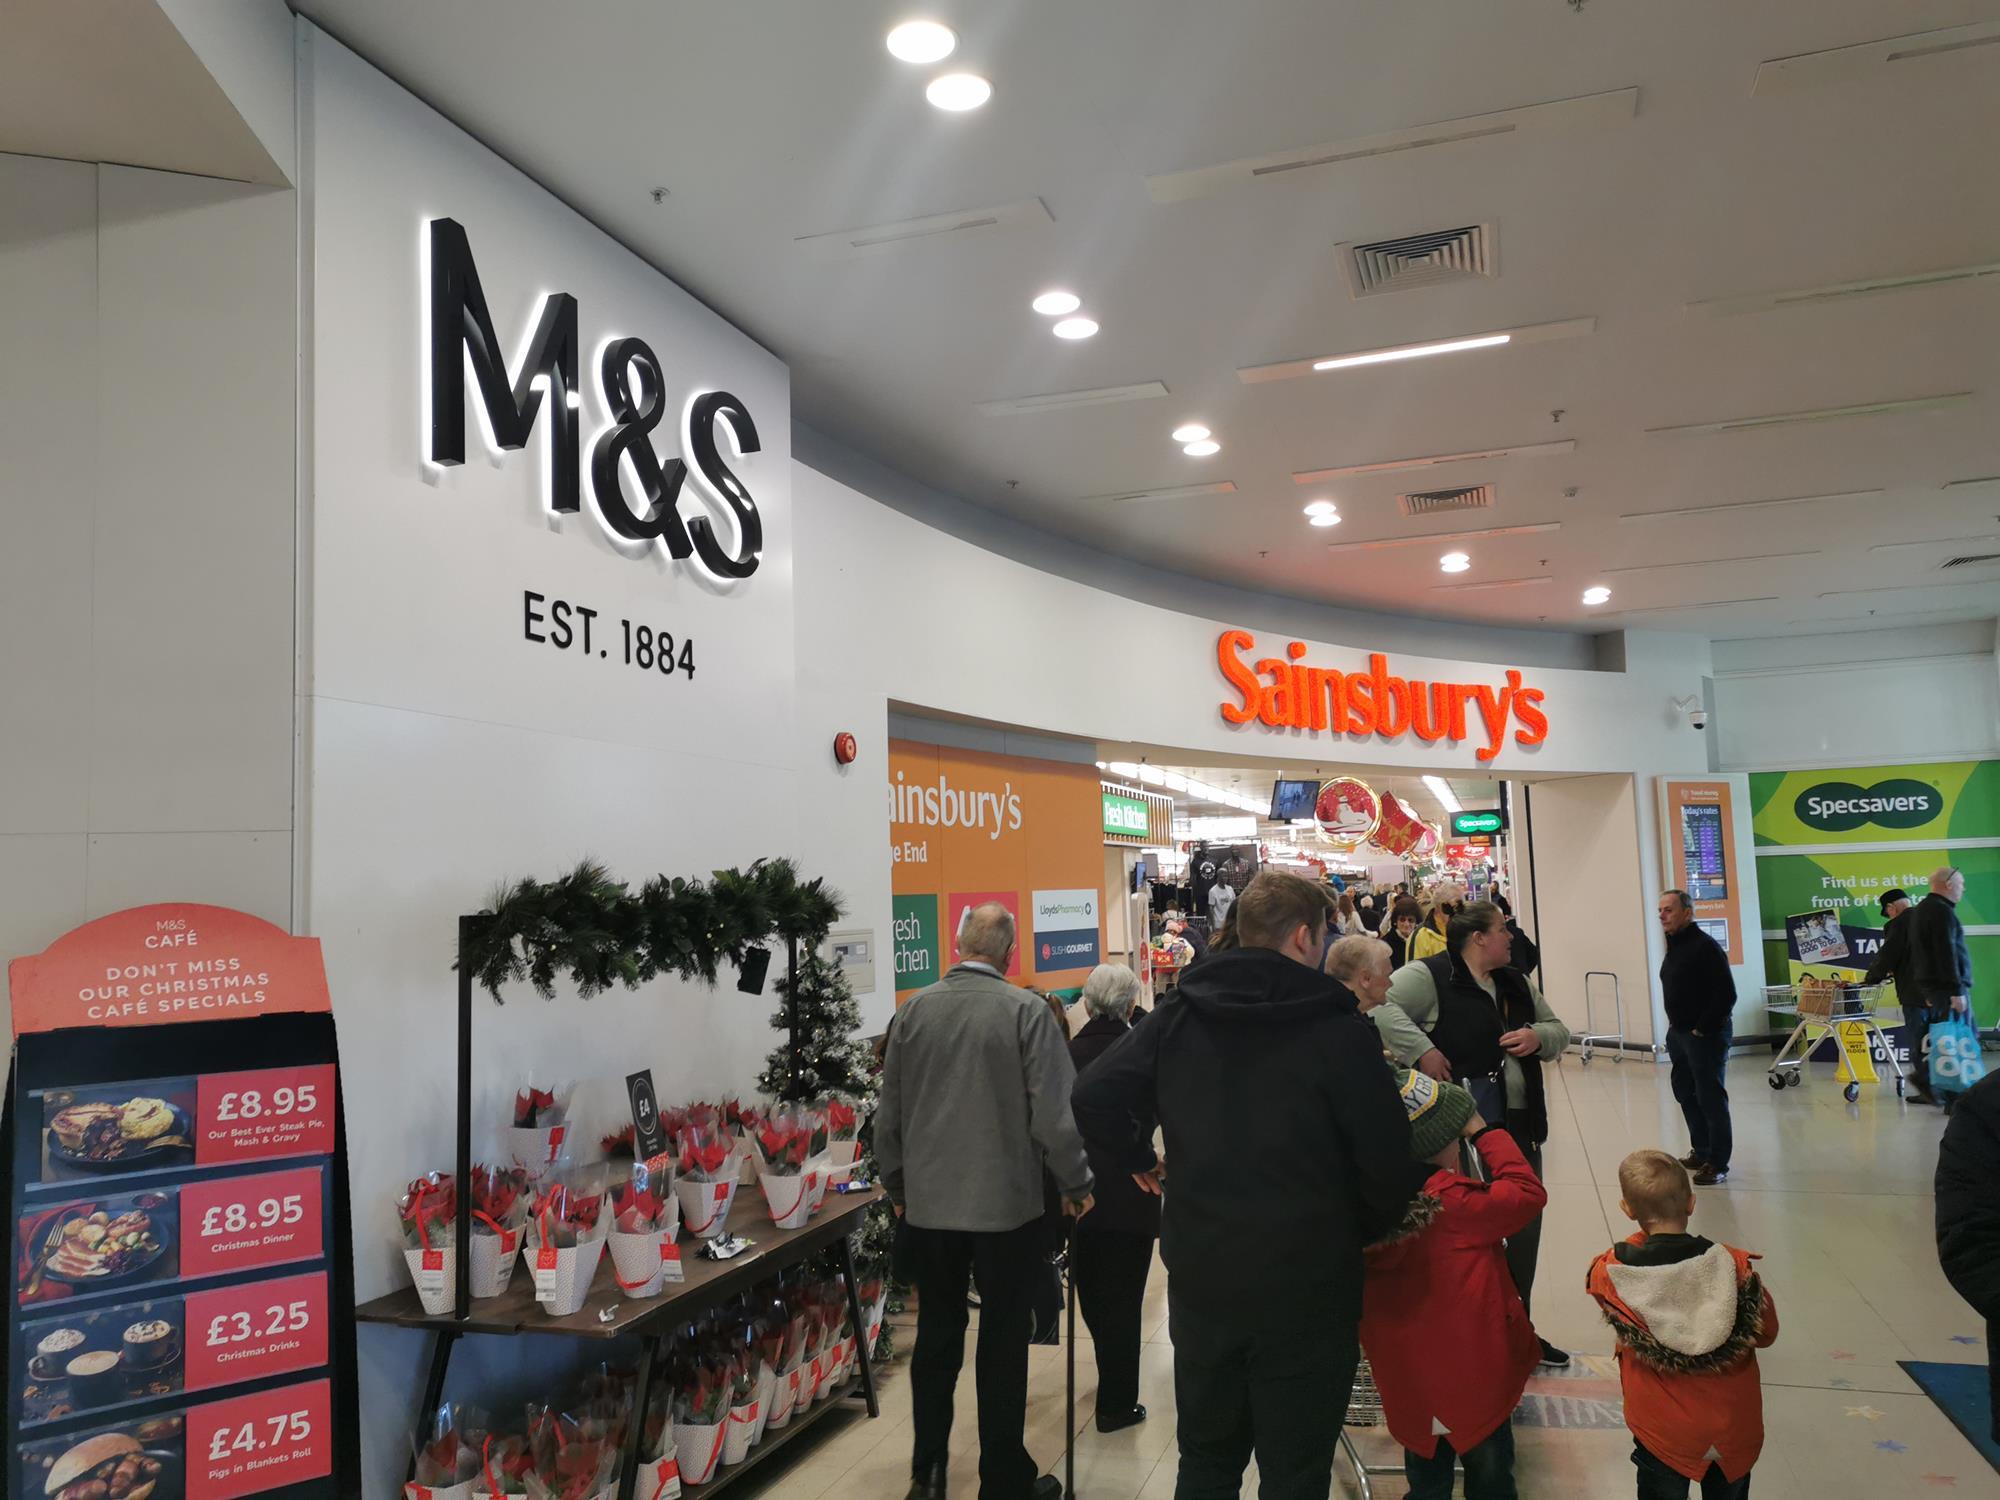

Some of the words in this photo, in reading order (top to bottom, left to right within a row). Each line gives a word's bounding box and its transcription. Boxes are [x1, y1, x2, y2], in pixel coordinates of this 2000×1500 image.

[430, 217, 763, 578] M&S
[524, 590, 607, 658] EST.
[621, 619, 696, 680] 1884
[1218, 630, 1548, 761] Sainsbury's
[888, 771, 1022, 840] ainsbury's
[1808, 796, 1929, 819] Specsavers
[1459, 819, 1497, 828] Specsavers
[904, 841, 927, 863] End
[1822, 875, 1857, 888] Find
[1860, 877, 1878, 888] us
[1882, 875, 1897, 887] at
[1902, 874, 1929, 886] the
[1811, 895, 1850, 908] front
[1854, 895, 1870, 906] of
[156, 920, 186, 931] M&S
[891, 912, 921, 941] resh
[145, 930, 198, 949] CAFÉ
[107, 963, 178, 980] DON'T
[188, 958, 240, 974] MISS
[894, 944, 930, 973] chen
[79, 985, 129, 1001] OUR
[139, 973, 269, 996] CHRISTMAS
[87, 999, 148, 1019] CAFÉ
[158, 990, 266, 1012] SPECIALS
[217, 1085, 317, 1121] £8.95
[639, 1098, 651, 1117] £4
[208, 1131, 227, 1139] Our
[231, 1127, 252, 1137] Best
[255, 1125, 276, 1134] Ever
[280, 1122, 305, 1131] Steak
[234, 1136, 259, 1147] Mash
[262, 1136, 270, 1144] &
[272, 1133, 301, 1143] Gravy
[201, 1195, 304, 1237] £8.95
[211, 1238, 260, 1253] Christmas
[263, 1233, 296, 1245] Dinner
[206, 1300, 310, 1347] £3.25
[217, 1346, 266, 1362] Christmas
[269, 1340, 301, 1352] Drinks
[208, 1410, 311, 1461] £4.75
[208, 1467, 230, 1480] Pigs
[233, 1464, 243, 1473] in
[246, 1453, 289, 1471] Blankets
[292, 1447, 312, 1460] Roll
